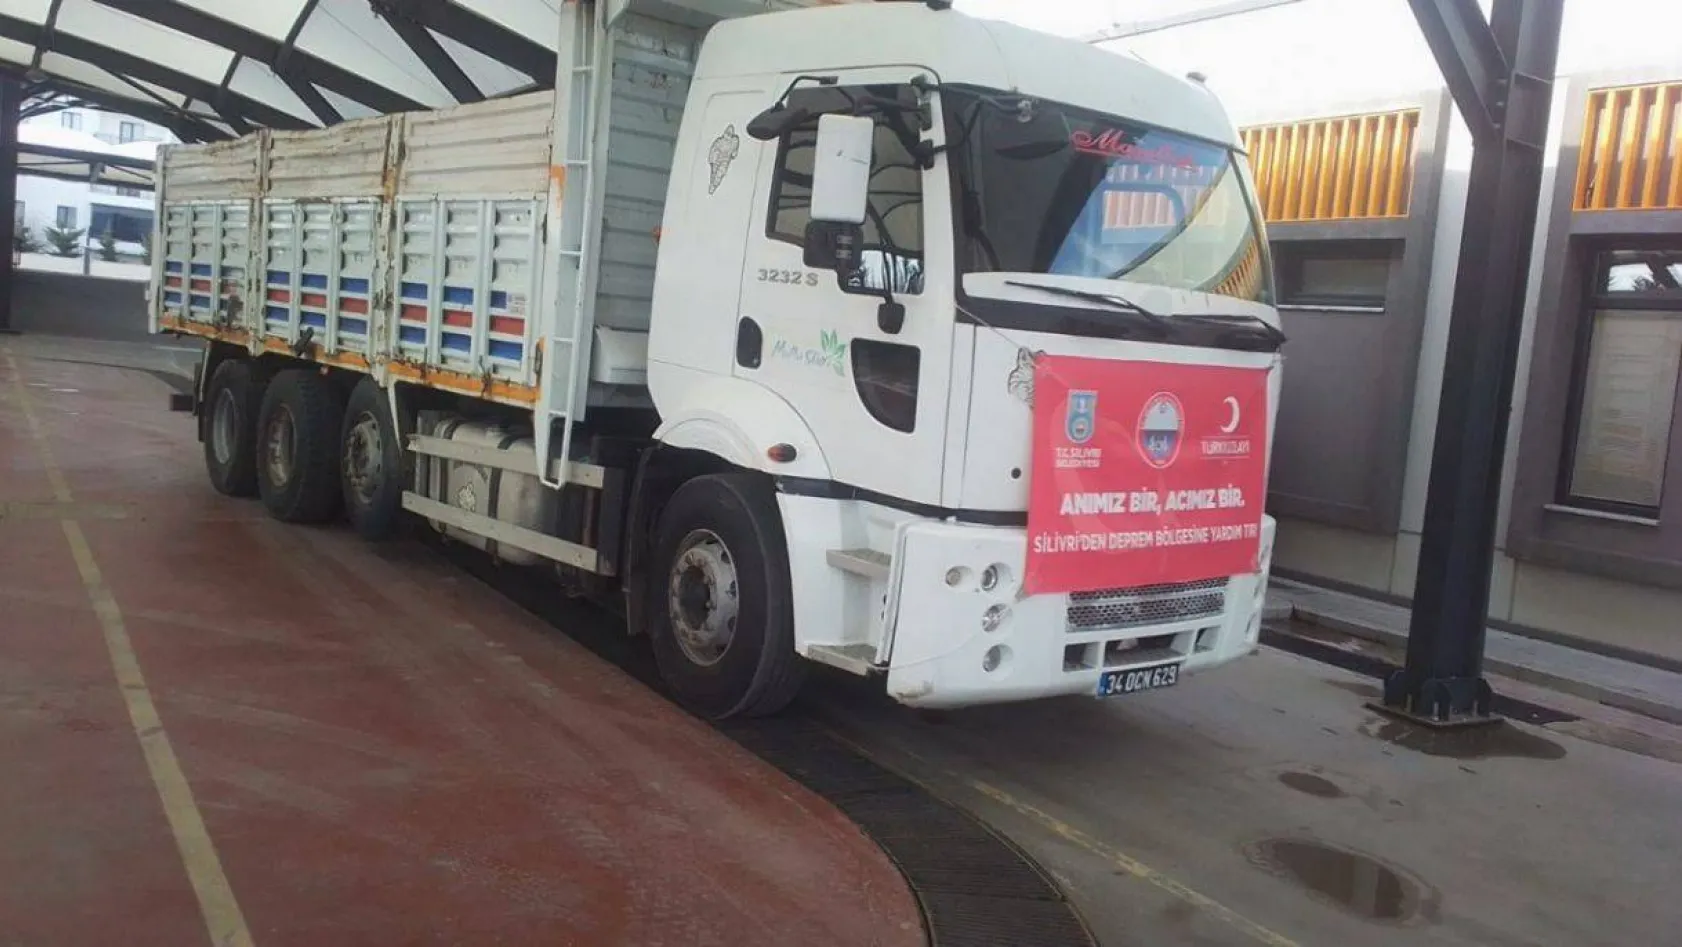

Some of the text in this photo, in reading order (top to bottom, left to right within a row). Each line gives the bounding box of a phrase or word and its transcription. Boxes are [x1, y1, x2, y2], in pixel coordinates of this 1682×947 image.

[757, 268, 819, 288] 3232 S
[1060, 492, 1127, 515] ANIMIZ
[1129, 486, 1161, 516] BİR,
[1108, 531, 1153, 550] DEPREM
[1155, 525, 1210, 546] BÖLGESİNE
[1210, 524, 1242, 543] YARDIM
[1106, 674, 1123, 694] 34
[1153, 666, 1177, 687] 629
